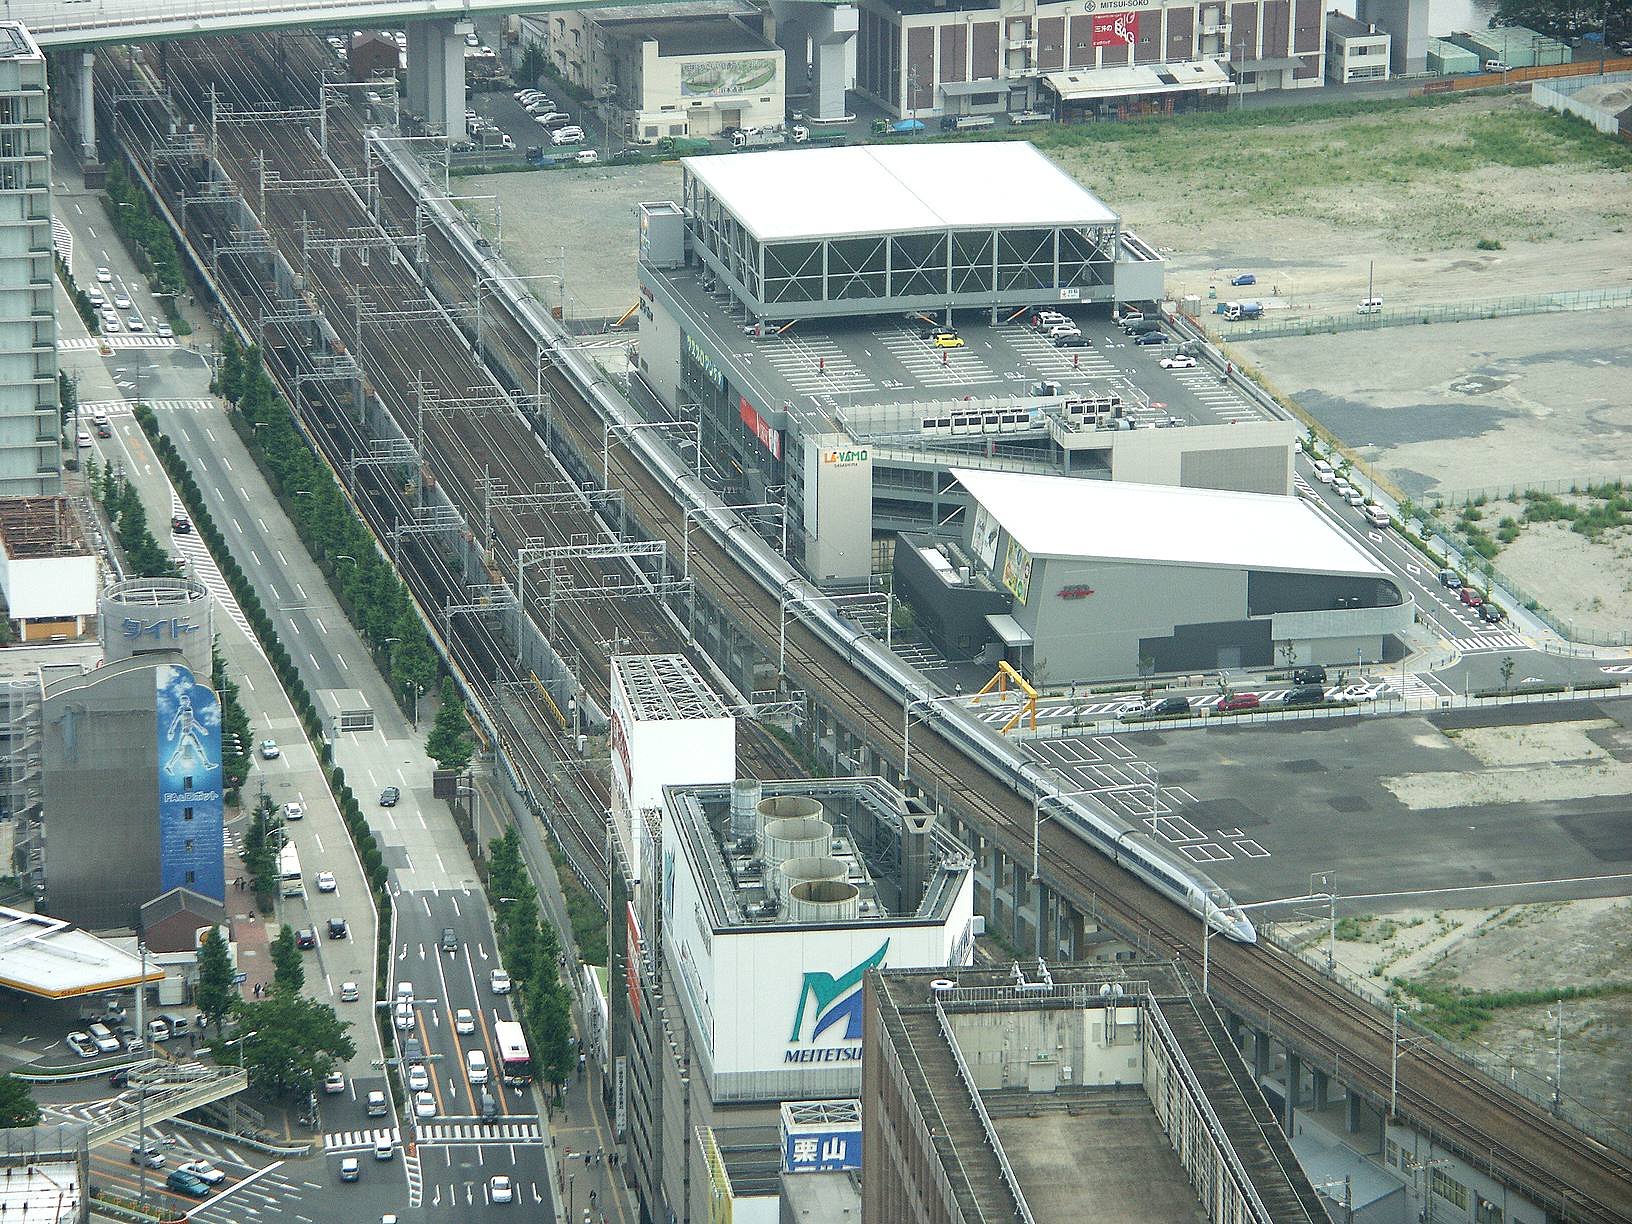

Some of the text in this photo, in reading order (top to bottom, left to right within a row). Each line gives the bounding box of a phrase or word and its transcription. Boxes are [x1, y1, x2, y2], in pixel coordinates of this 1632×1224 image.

[1100, 0, 1149, 8] MITSUI-SOKO
[784, 1047, 862, 1063] MEITETSU
[793, 1136, 847, 1163] 栗山
